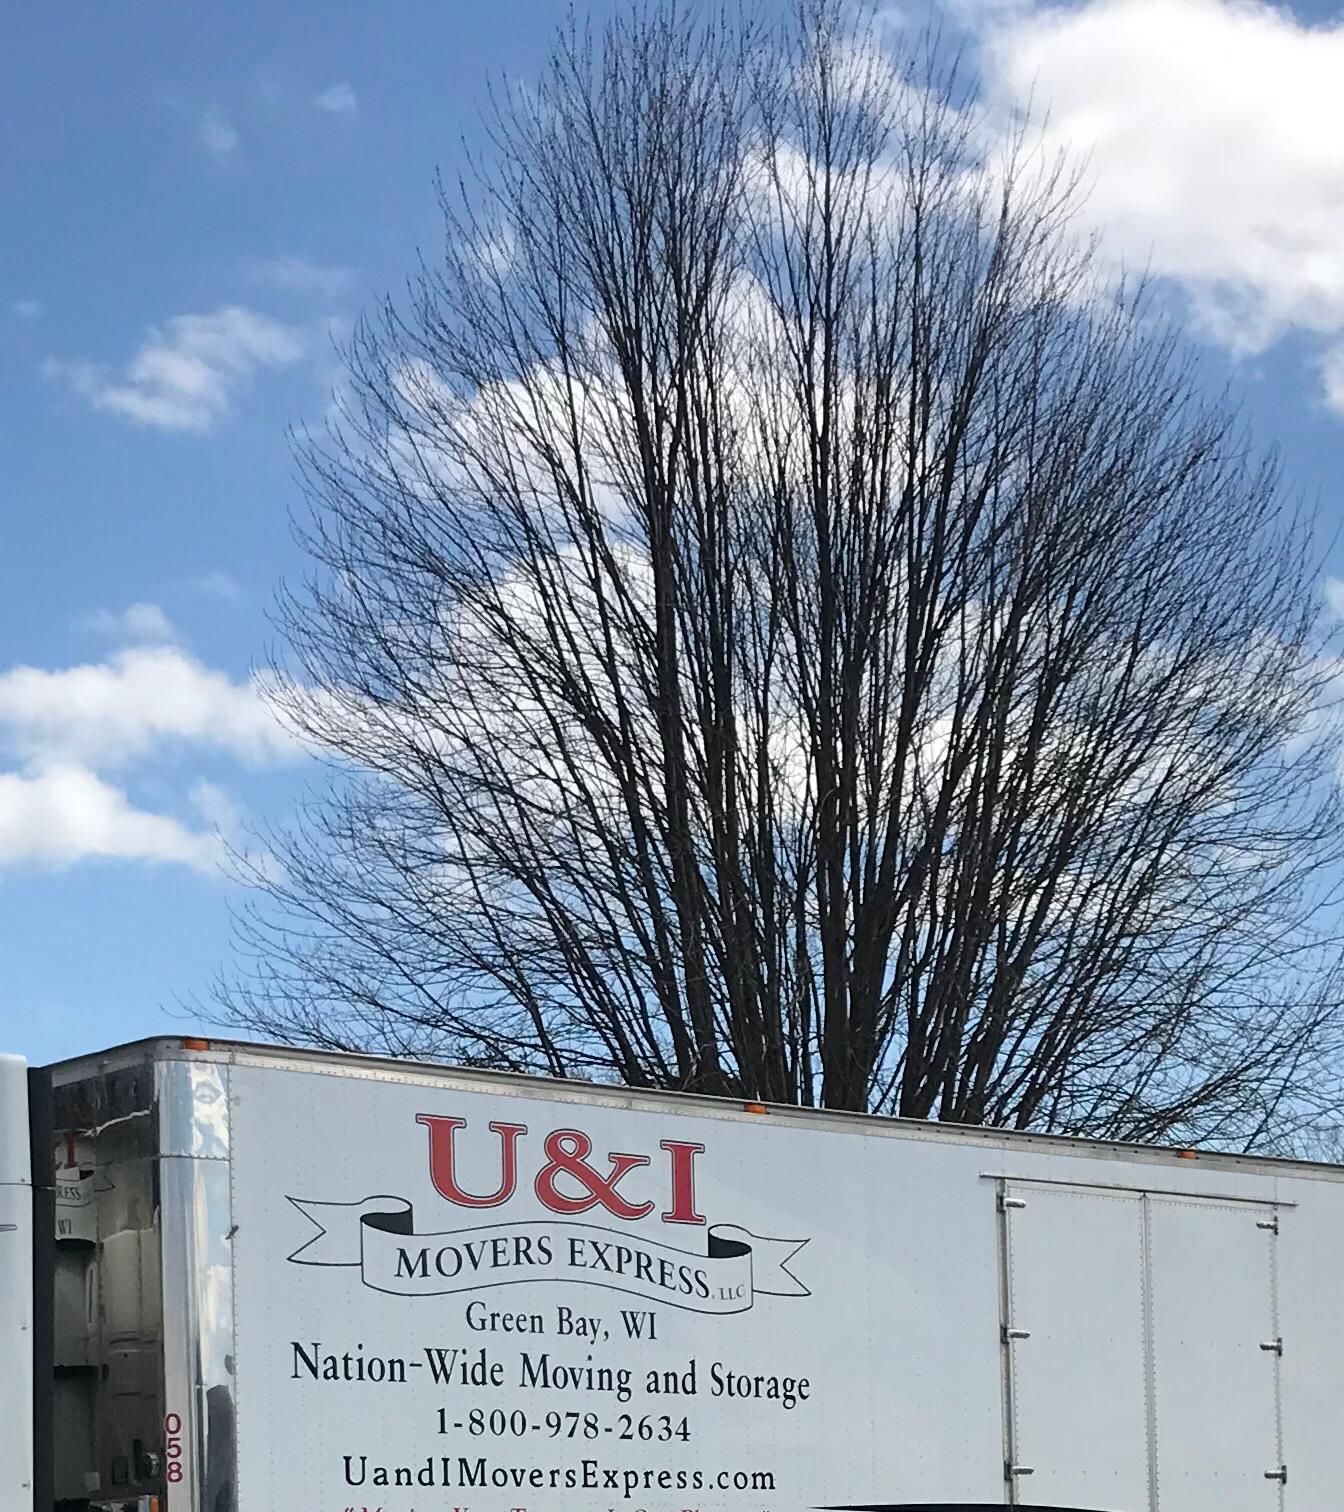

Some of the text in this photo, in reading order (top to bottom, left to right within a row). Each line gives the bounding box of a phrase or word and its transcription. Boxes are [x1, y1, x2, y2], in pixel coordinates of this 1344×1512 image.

[415, 1112, 706, 1226] U&I
[393, 1235, 554, 1279] MOVERS
[718, 1284, 746, 1301] LLC
[465, 1300, 657, 1345] Green Bay, WI
[290, 1341, 811, 1410] Nation-Wide Moving and Storage
[164, 1412, 184, 1483] 058
[436, 1408, 692, 1442] 1-800-978-2634
[343, 1455, 777, 1498] UandIMoversExpress.com
